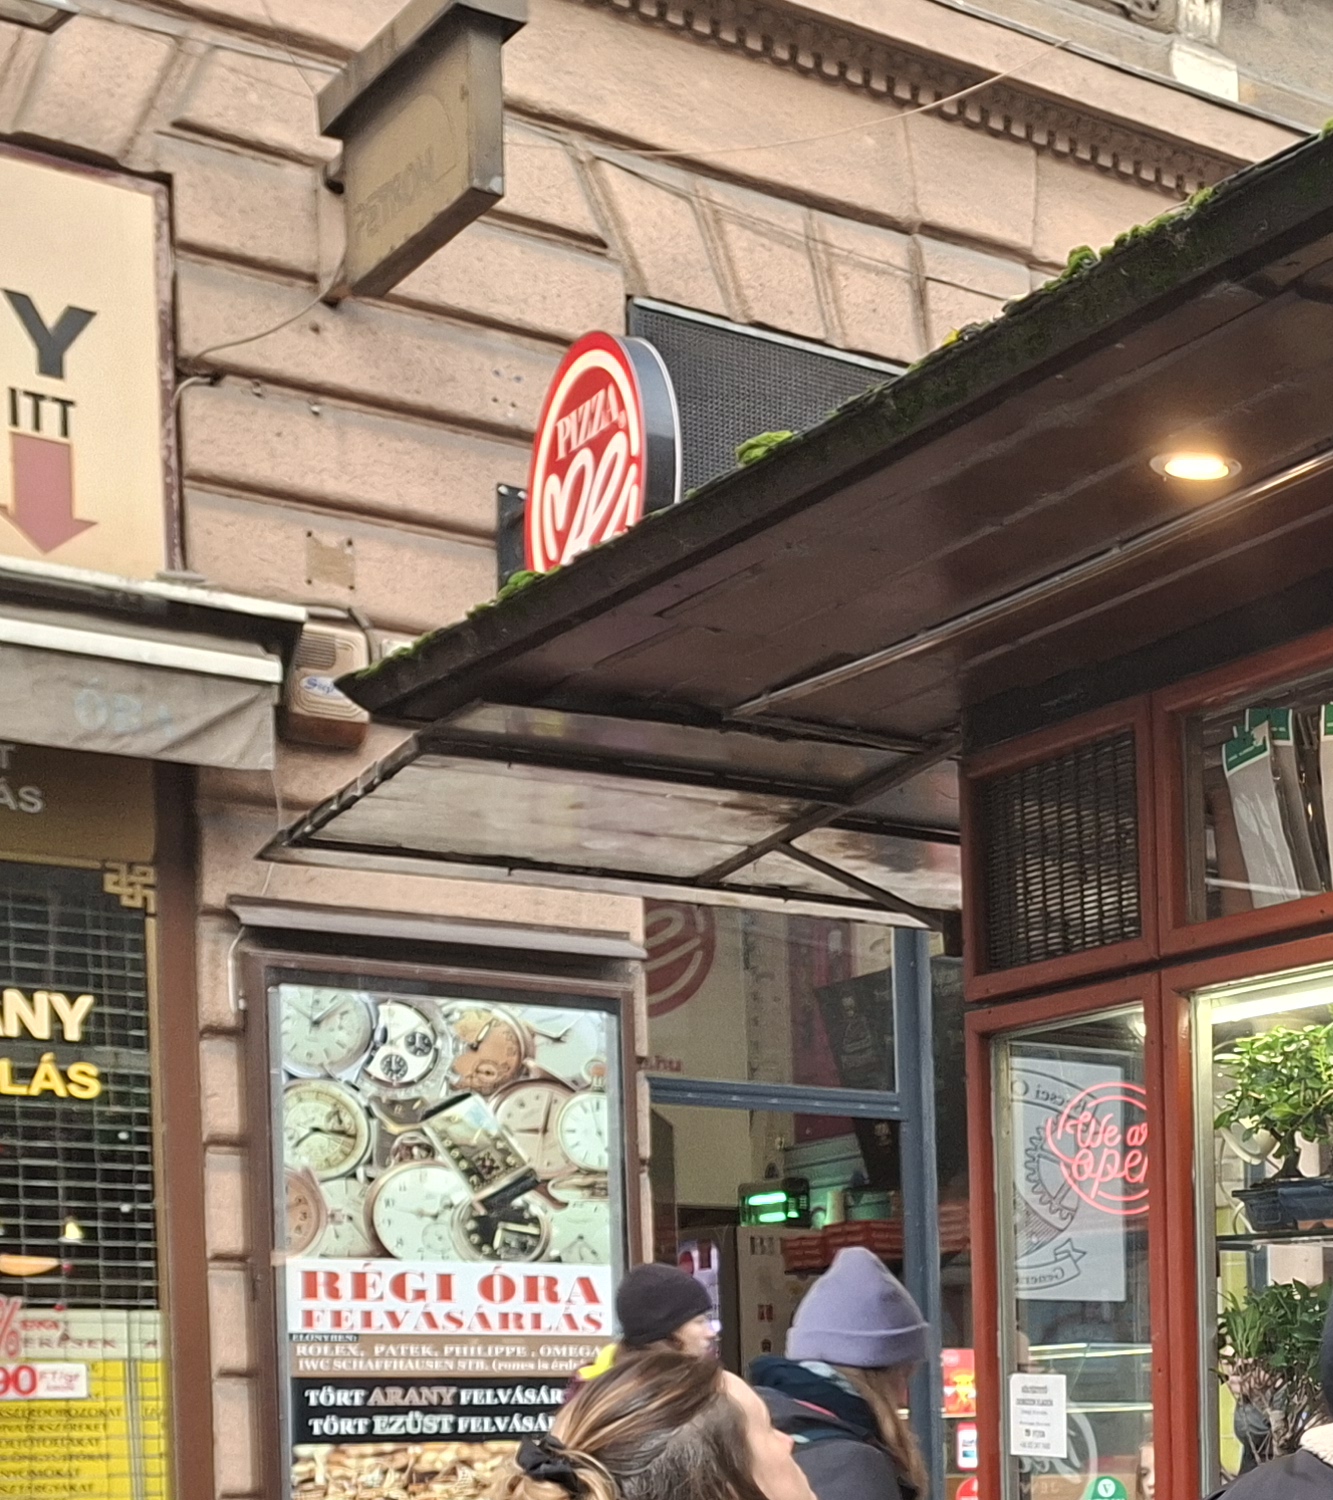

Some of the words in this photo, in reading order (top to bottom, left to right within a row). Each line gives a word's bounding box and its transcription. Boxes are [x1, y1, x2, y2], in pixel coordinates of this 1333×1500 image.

[3, 290, 97, 379] Y
[8, 388, 76, 438] ITT
[556, 383, 619, 461] PIZZA
[0, 988, 94, 1042] NY
[1066, 1111, 1121, 1148] We
[300, 1262, 456, 1304] RÉGI
[477, 1265, 603, 1305] ÓRA
[300, 1302, 604, 1332] FELVÁSÁRLÁS
[298, 1358, 330, 1372] IWC
[333, 1358, 453, 1372] SCHAFFHAUSEN
[304, 1385, 366, 1406] TÖRT
[366, 1385, 457, 1407] ARANY
[308, 1414, 370, 1436] TÖRT
[371, 1410, 455, 1436] EZÜST
